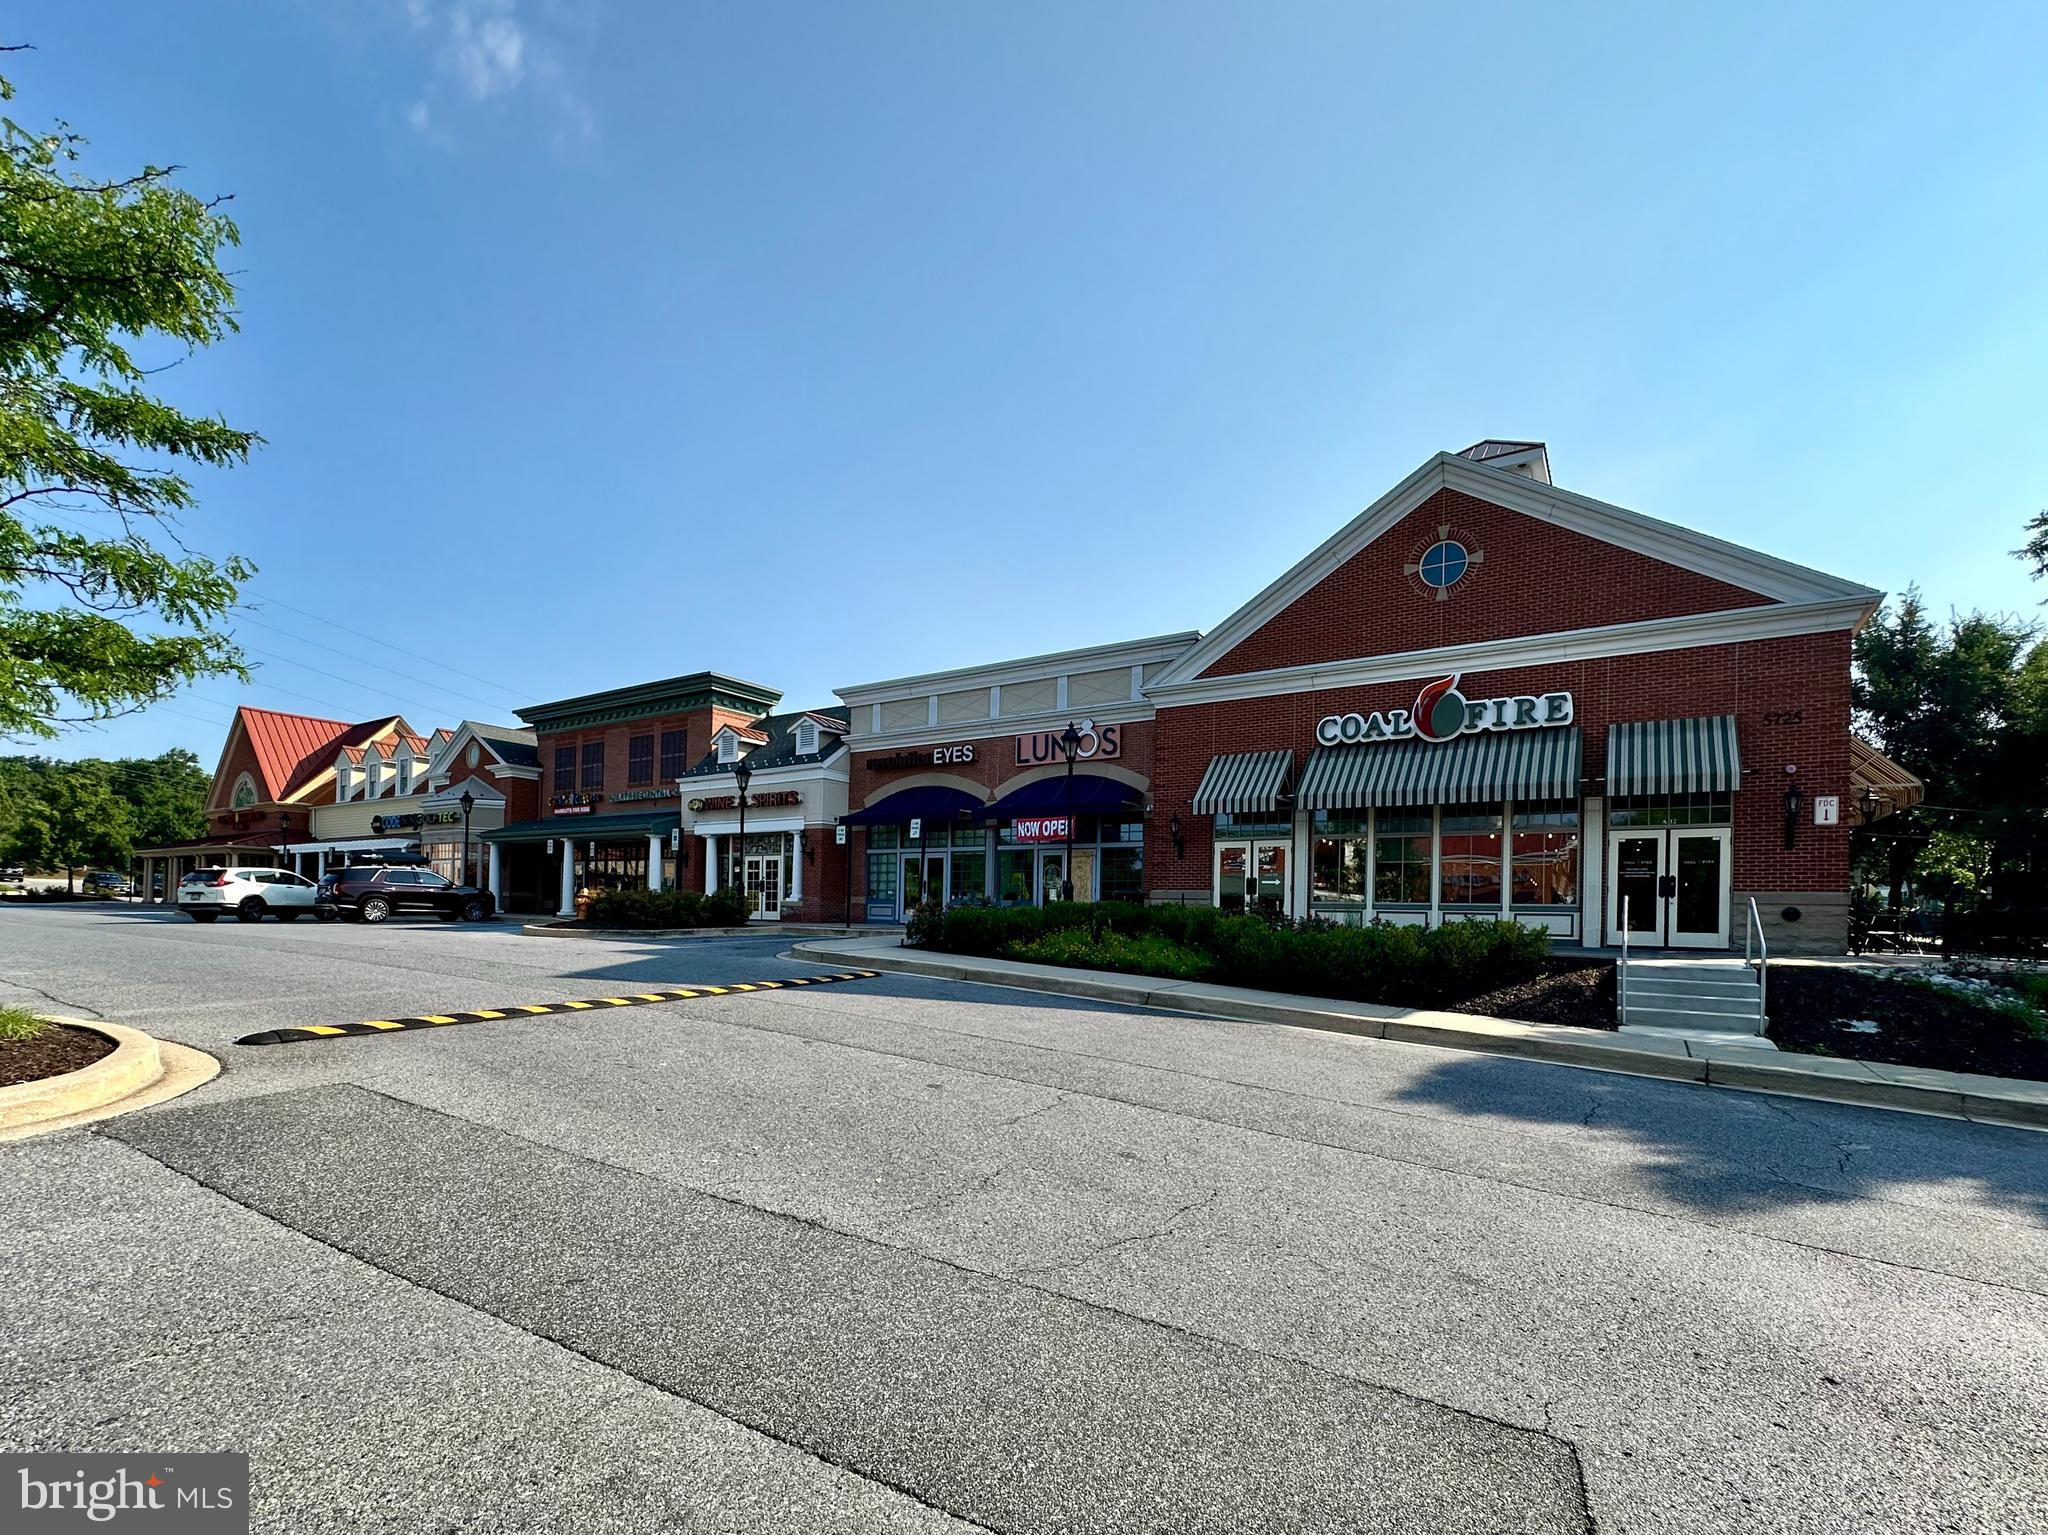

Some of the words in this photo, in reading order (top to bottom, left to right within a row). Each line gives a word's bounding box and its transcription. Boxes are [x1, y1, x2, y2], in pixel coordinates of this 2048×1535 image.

[1319, 712, 1412, 743] COAL
[1464, 694, 1570, 730] FIRE
[933, 745, 973, 764] EYES
[704, 796, 734, 810] WINE
[751, 790, 799, 808] SPIRITS
[382, 814, 400, 829] CODE
[1017, 821, 1041, 837] NOW
